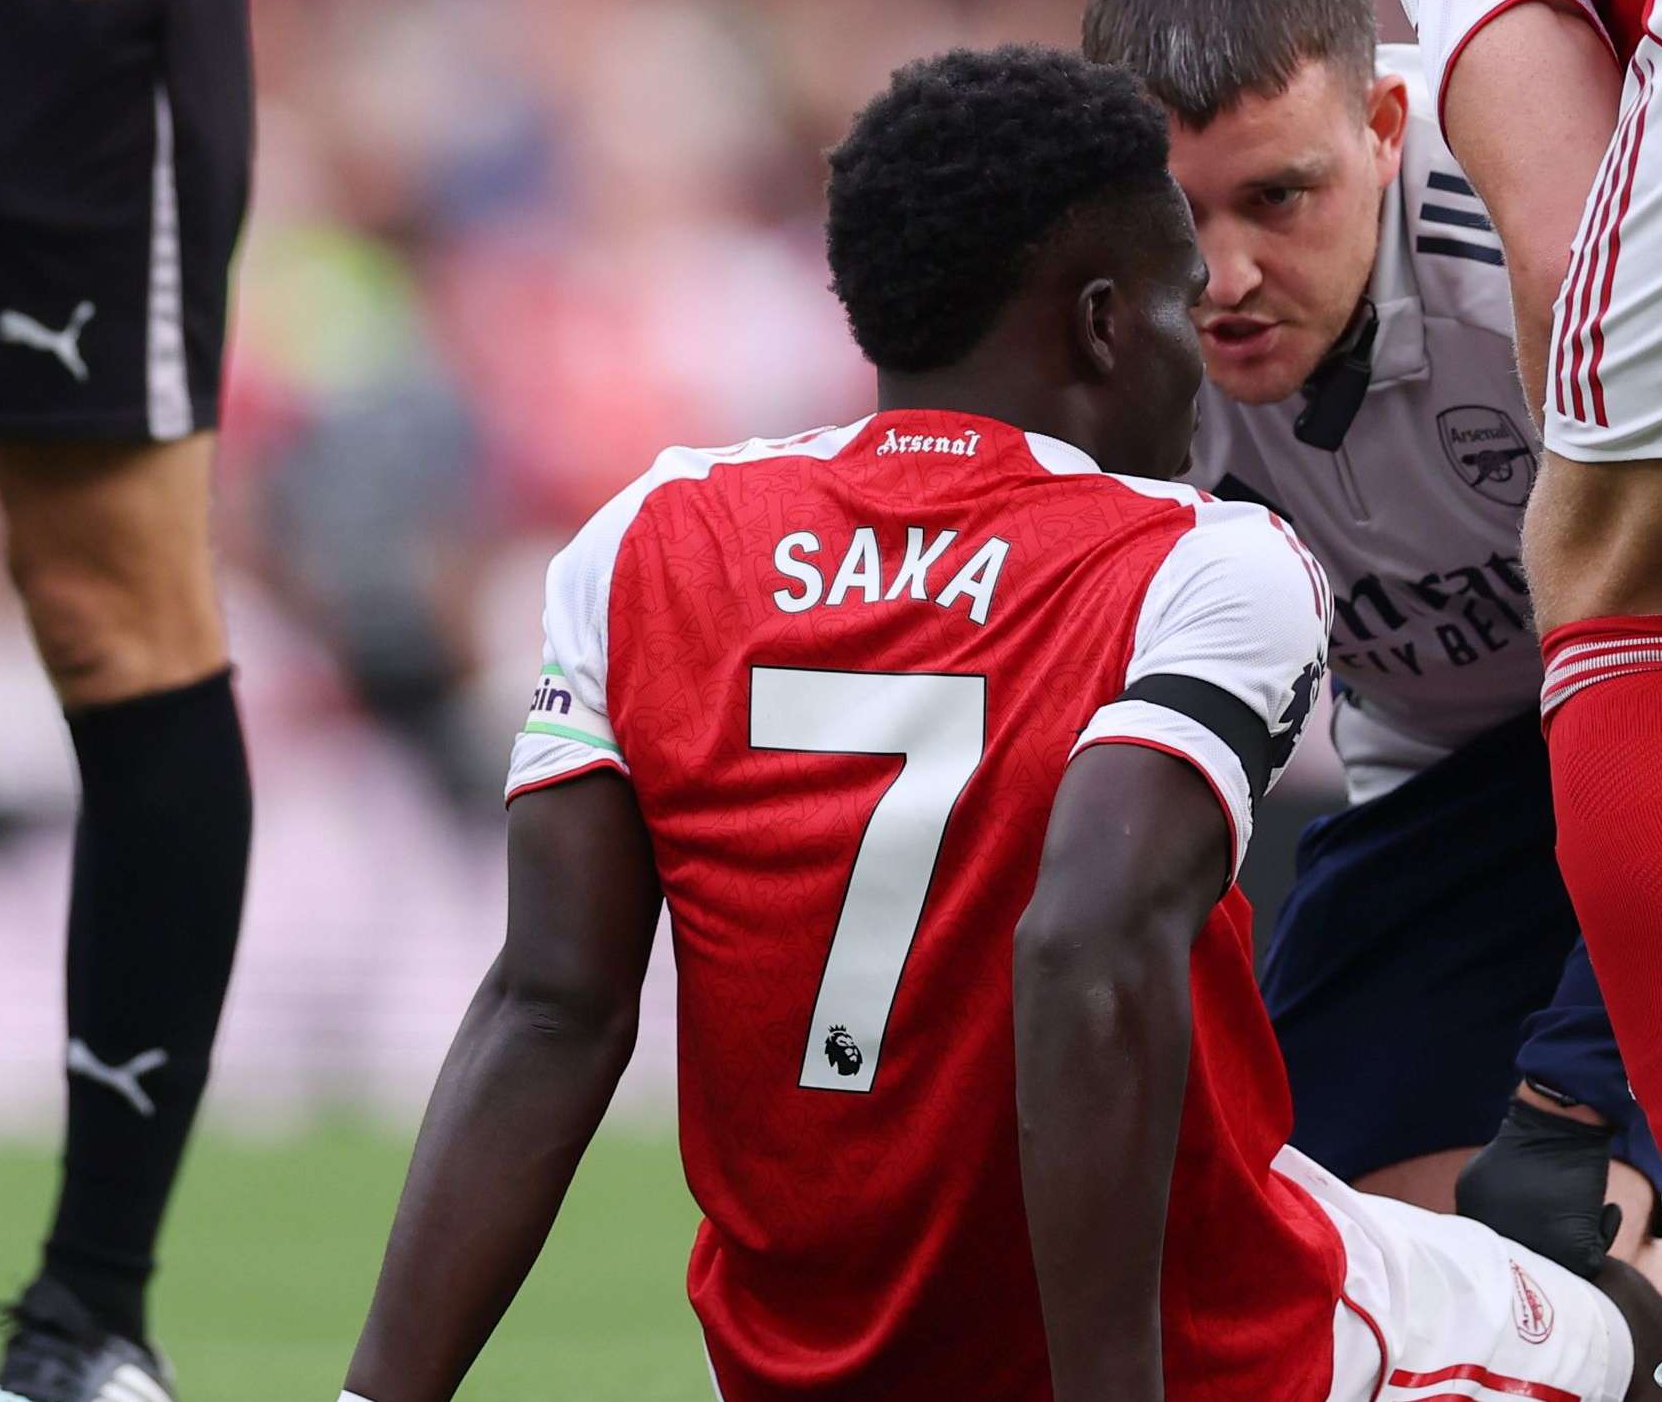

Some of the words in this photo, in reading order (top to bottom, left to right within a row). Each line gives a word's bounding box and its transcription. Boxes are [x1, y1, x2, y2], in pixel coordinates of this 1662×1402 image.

[876, 428, 981, 456] Arsenal
[773, 525, 1012, 628] SAKA
[748, 664, 988, 1094] 7
